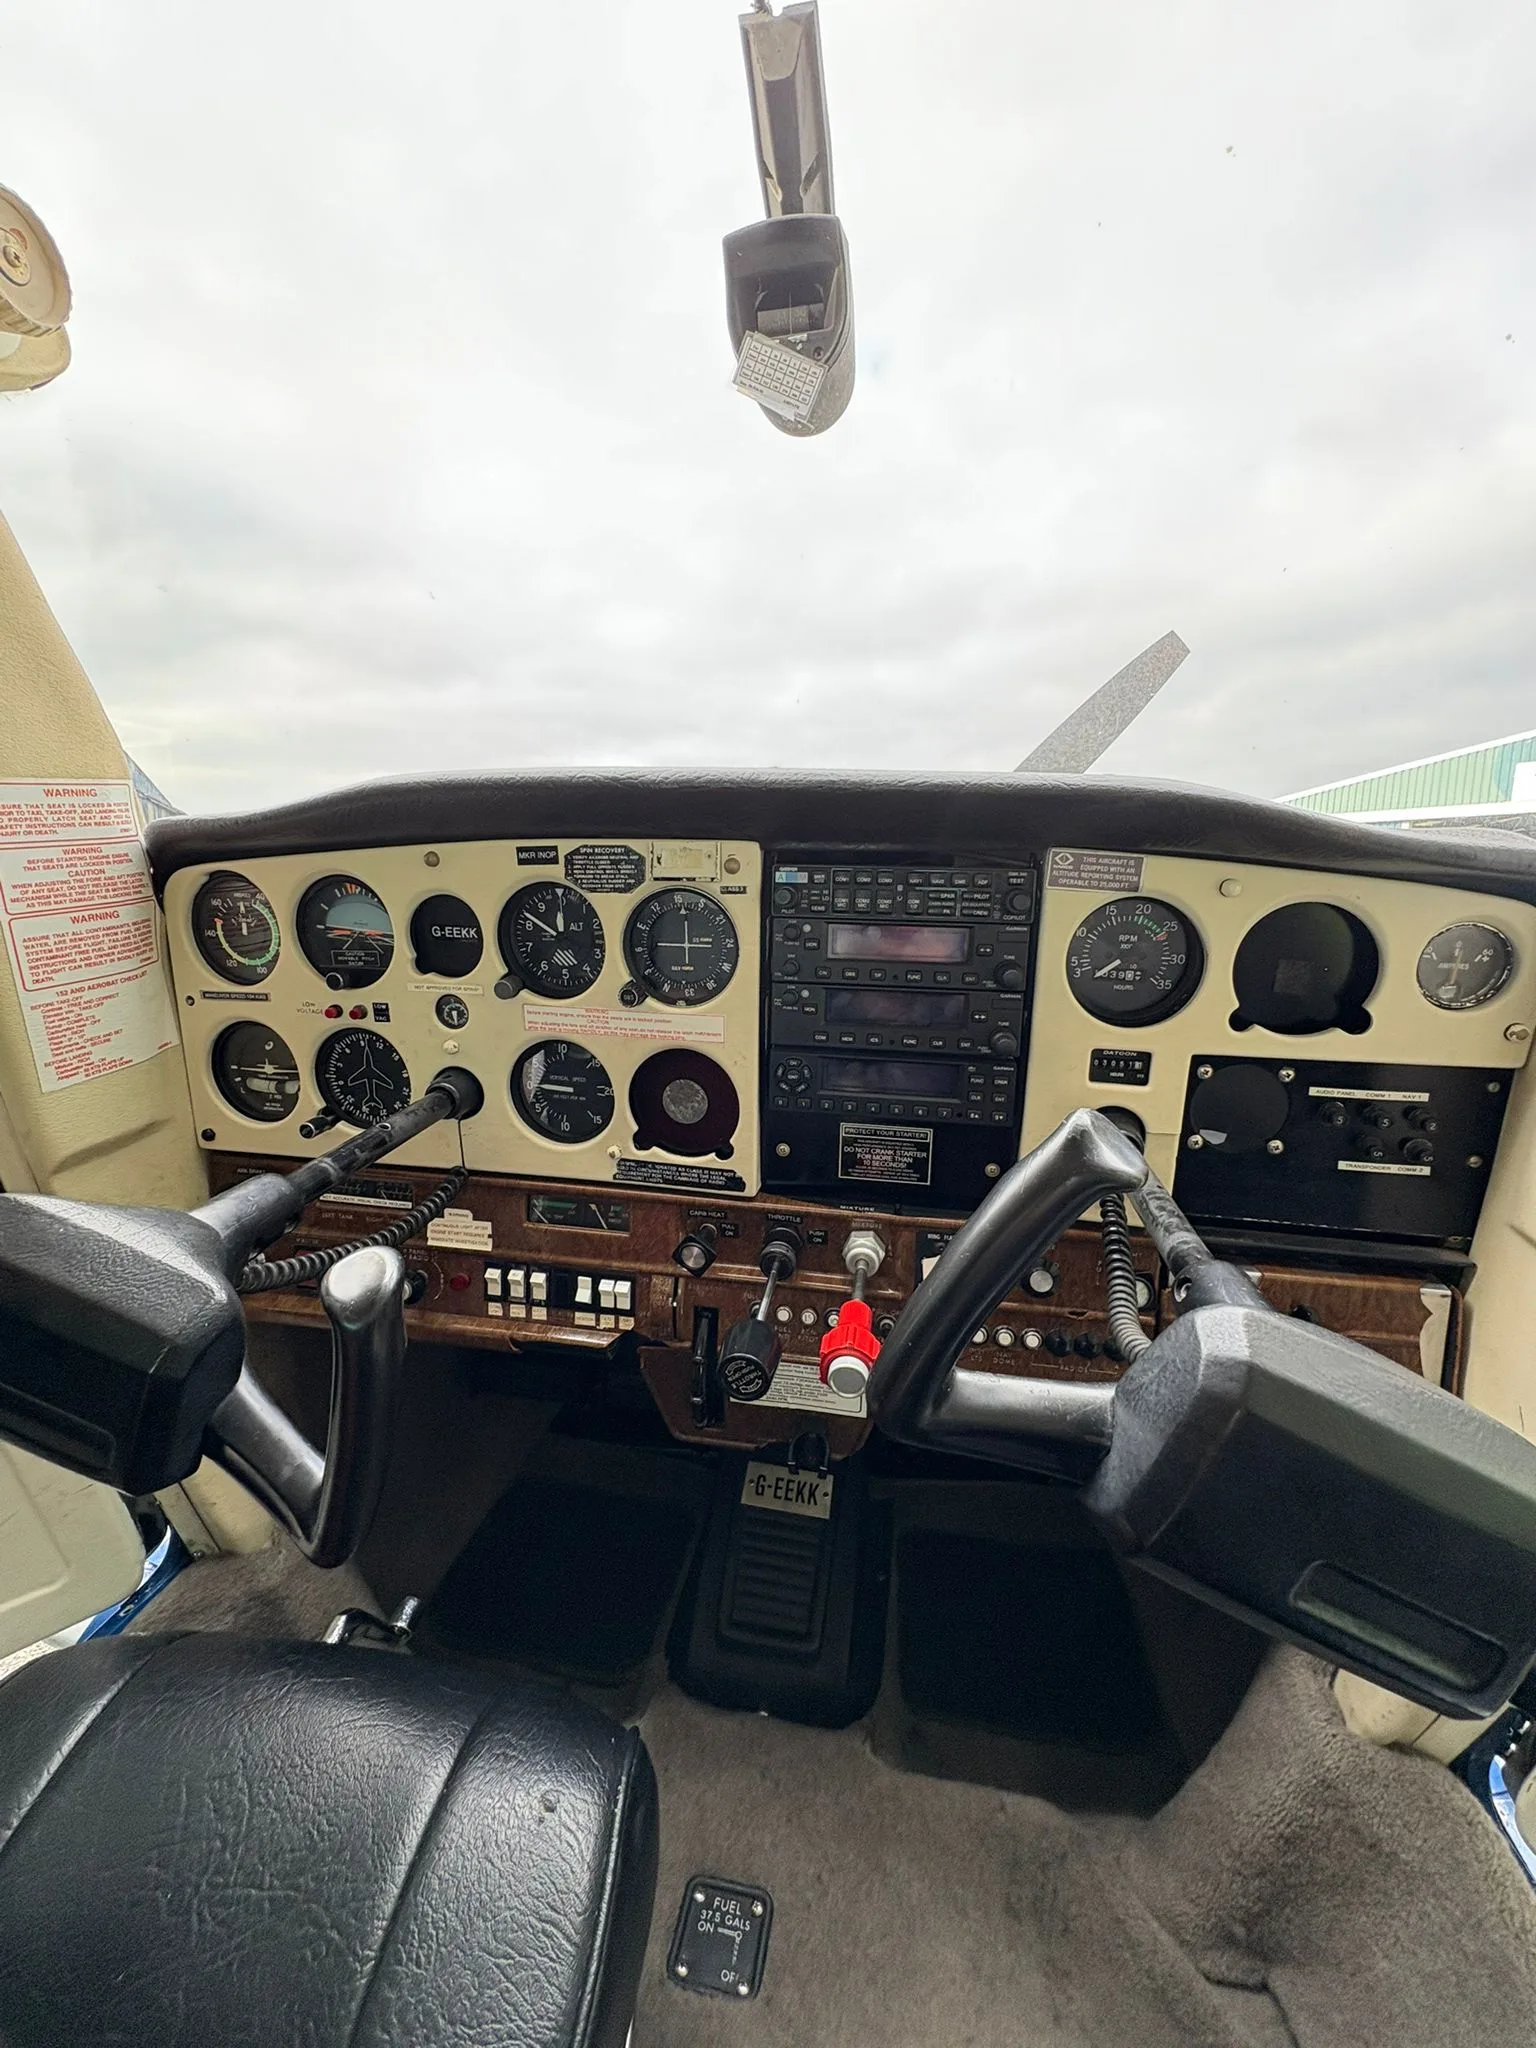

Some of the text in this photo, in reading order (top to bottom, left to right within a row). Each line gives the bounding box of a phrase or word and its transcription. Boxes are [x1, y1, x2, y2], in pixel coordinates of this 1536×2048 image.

[43, 789, 97, 798] WARNING
[62, 847, 103, 855] WARNING
[518, 851, 557, 860] MKR INOP
[68, 869, 105, 878] CAUTION
[1081, 872, 1114, 880] REPORTING
[1058, 878, 1089, 886] OPERABLE
[1099, 881, 1120, 889] 25,000
[674, 895, 683, 904] 15
[699, 899, 706, 908] S
[538, 903, 546, 913] 9
[651, 902, 662, 913] 12
[1106, 905, 1117, 916] 15
[1136, 904, 1152, 915] 20
[70, 911, 120, 924] WARNING
[716, 914, 726, 925] 21
[526, 921, 533, 931] 8
[569, 923, 584, 931] ALT
[593, 919, 600, 929] 2
[637, 921, 647, 930] E
[1163, 921, 1178, 932] 25
[431, 926, 479, 939] G-EEKK
[1077, 927, 1087, 938] 10
[69, 936, 101, 944] REMOVED
[725, 938, 734, 948] 24
[25, 944, 82, 957] SYSTEM BEFORE
[526, 942, 533, 952] 7
[27, 953, 73, 964] CONTAMINANT
[594, 949, 602, 959] 3
[1071, 956, 1079, 967] 5
[1170, 954, 1186, 965] 30
[29, 959, 78, 971] INSTRUCTIONS
[42, 968, 67, 976] FLIGHT
[84, 960, 108, 969] RESULT
[541, 961, 549, 971] 6
[582, 963, 590, 972] 4
[723, 963, 733, 973] W
[562, 969, 570, 979] 5
[1073, 968, 1081, 978] 3
[70, 987, 86, 995] AND
[87, 980, 119, 991] AEROBAT
[706, 979, 717, 991] 30
[1157, 980, 1172, 990] 35
[685, 989, 695, 997] 33
[558, 1044, 568, 1053] 10
[592, 1059, 600, 1067] 15
[535, 1104, 541, 1112] 5
[593, 1116, 602, 1124] 15
[1383, 1119, 1390, 1127] 5
[561, 1122, 570, 1131] 10
[1430, 1122, 1436, 1130] 2
[1345, 1163, 1391, 1171] TRANSPONDER
[768, 1214, 801, 1223] THROTTLE
[755, 1474, 820, 1506] G-EEKK
[713, 1897, 742, 1915] FUEL
[698, 1921, 715, 1934] ON
[725, 1915, 751, 1931] GALS
